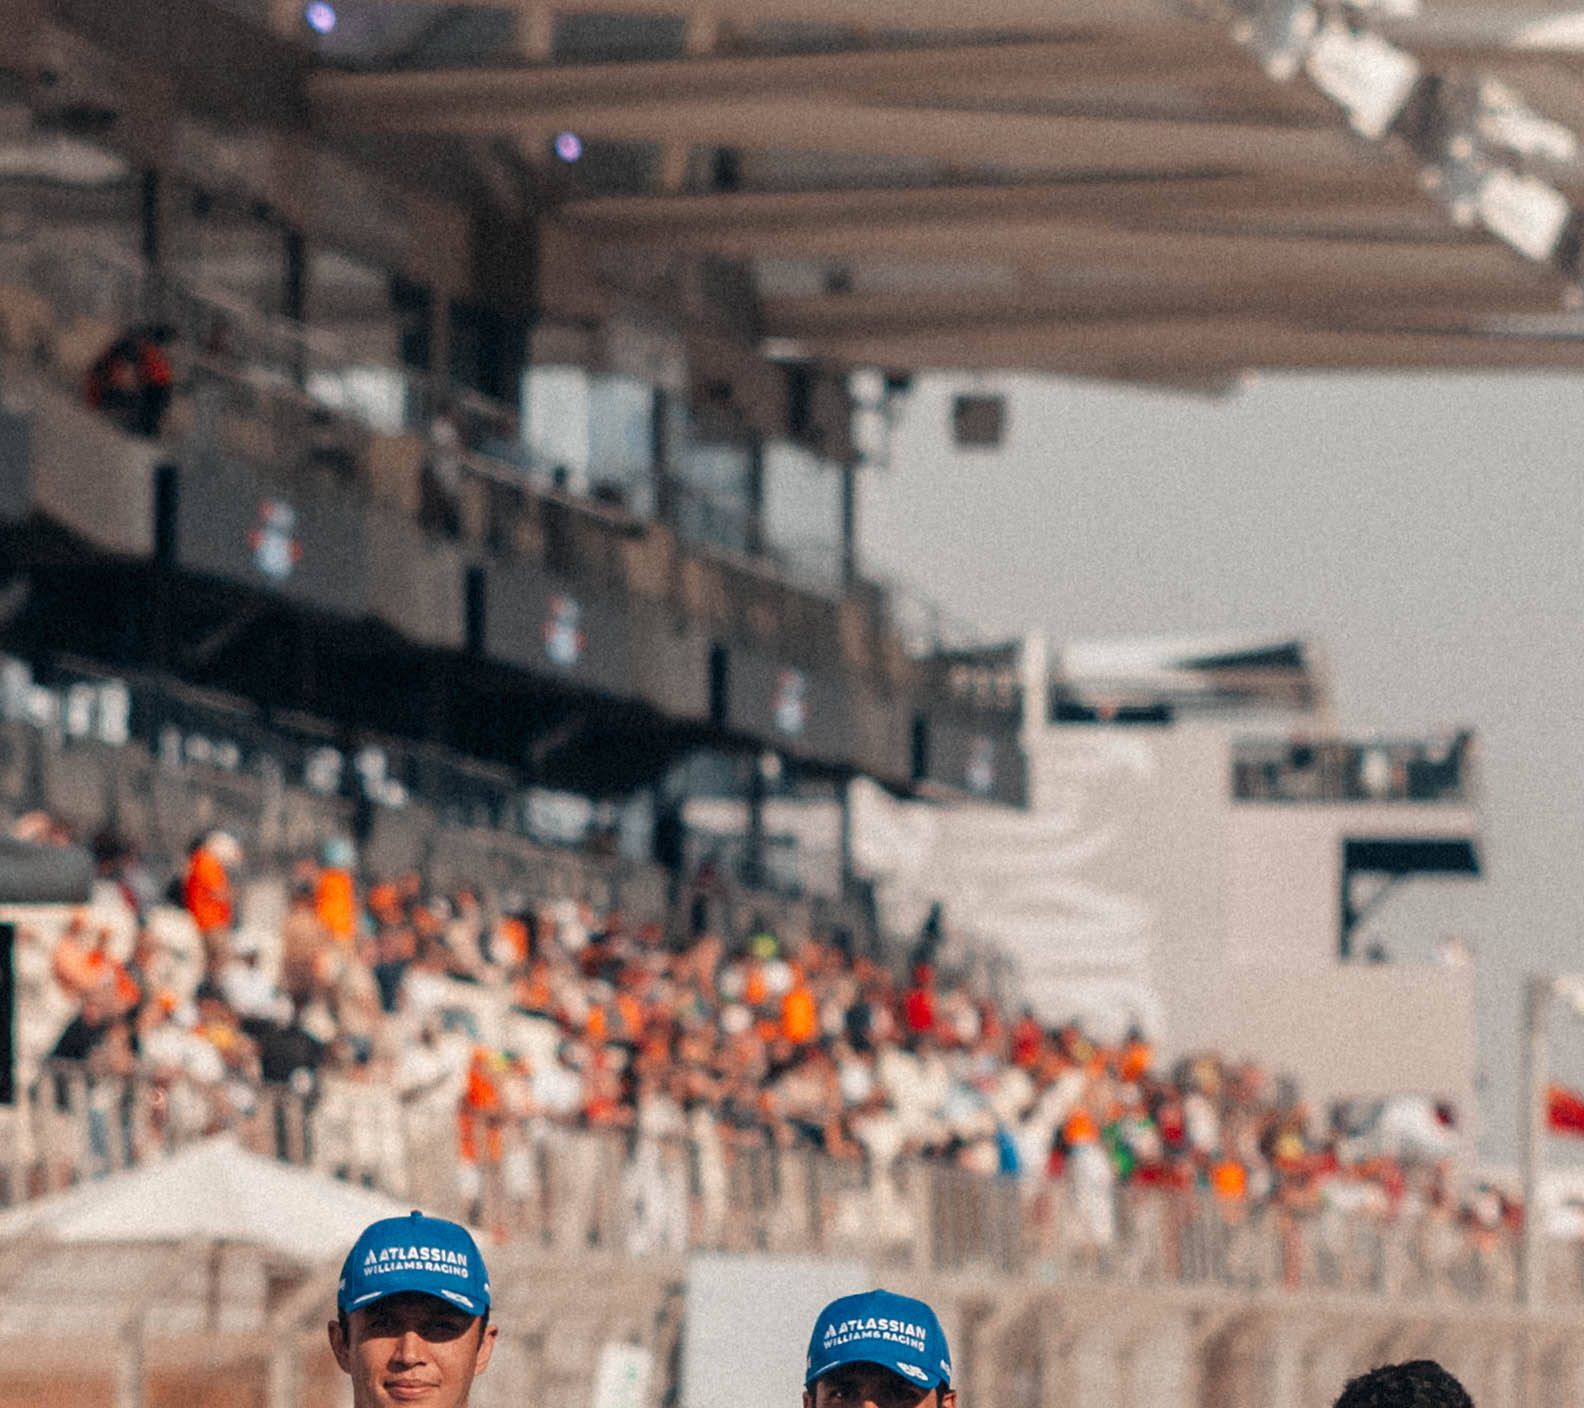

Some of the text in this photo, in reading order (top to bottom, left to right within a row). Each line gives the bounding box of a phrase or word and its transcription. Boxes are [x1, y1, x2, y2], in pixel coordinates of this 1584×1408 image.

[380, 1247, 468, 1266] ATLASSIAN
[364, 1262, 468, 1278] WILLIAMS RACING
[839, 1318, 926, 1339] ATLASSIAN
[882, 1331, 926, 1352] RACING
